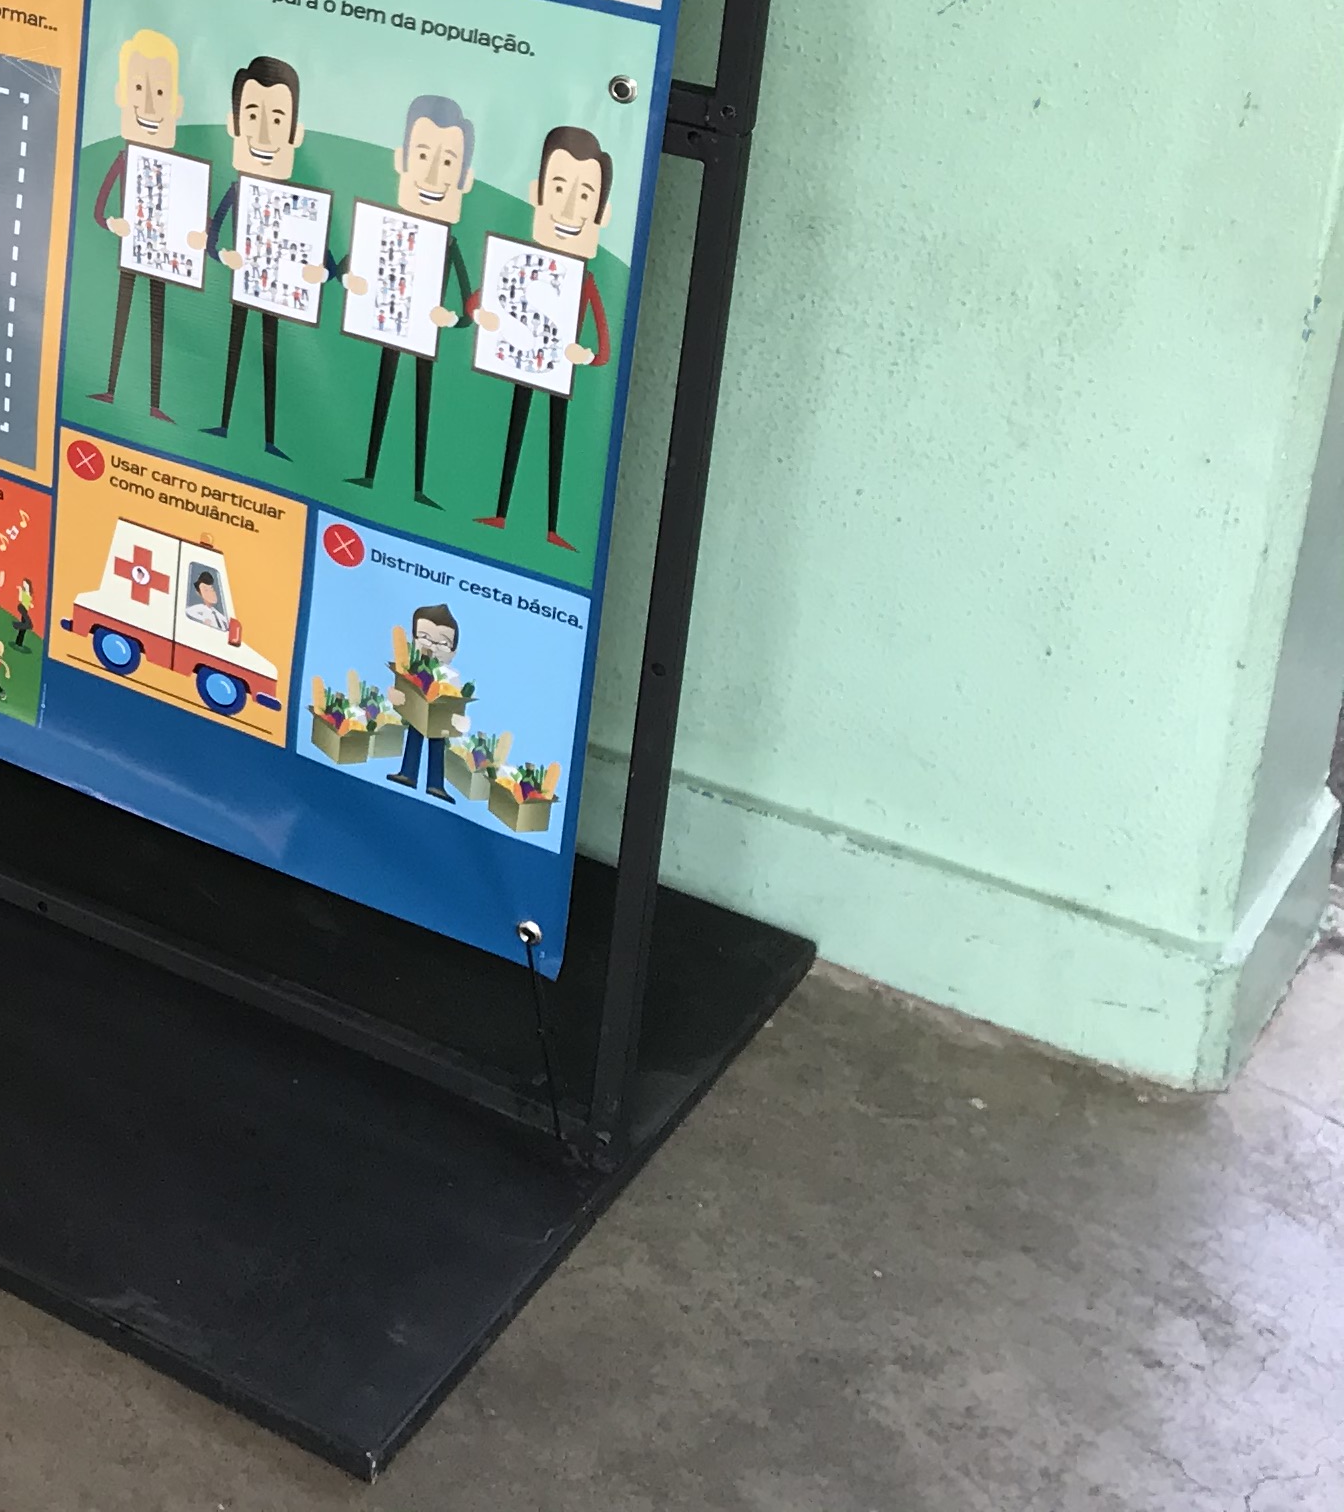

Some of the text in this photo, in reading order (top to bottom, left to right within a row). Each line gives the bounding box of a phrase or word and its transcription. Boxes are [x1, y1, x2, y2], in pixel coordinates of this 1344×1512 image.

[341, 0, 387, 24] bem
[390, 11, 417, 31] da
[421, 17, 535, 58] população.
[109, 476, 259, 533] como ambulância.
[110, 455, 286, 521] Usar carro particular
[370, 547, 584, 630] Distribuir cesta básica.
